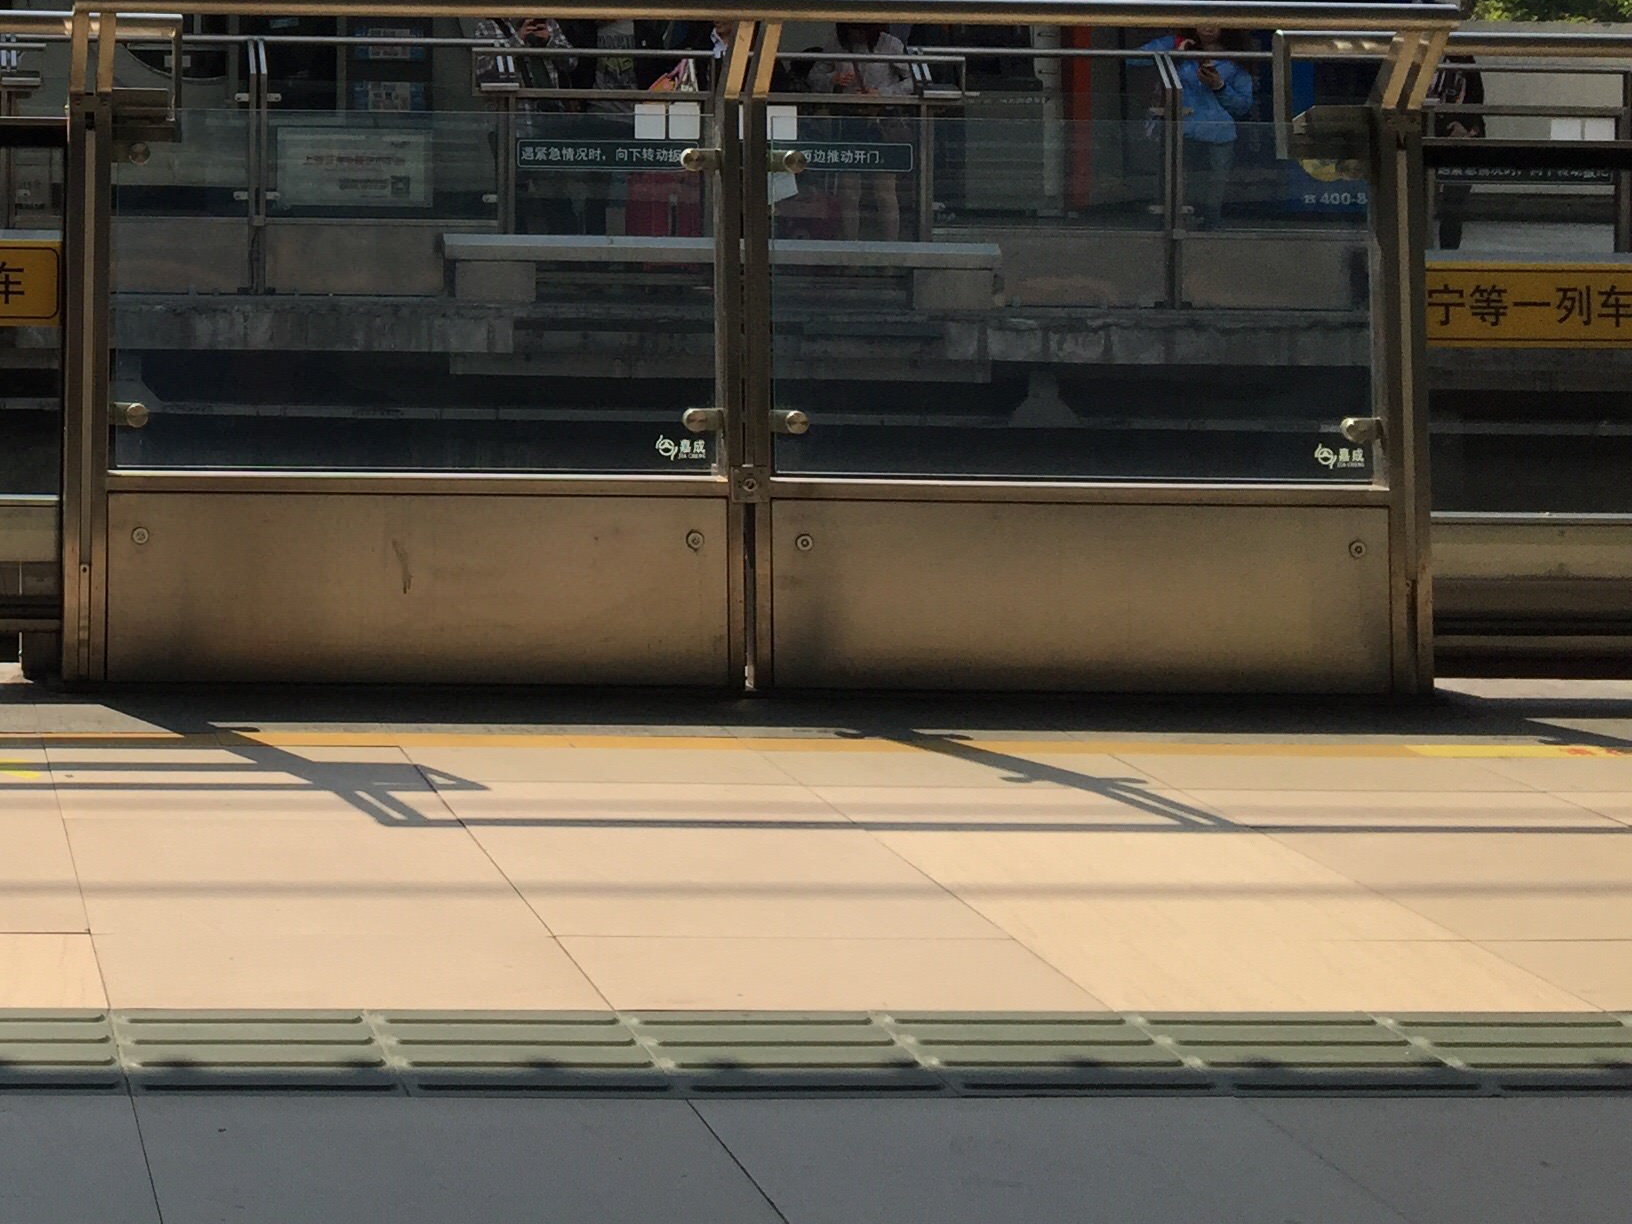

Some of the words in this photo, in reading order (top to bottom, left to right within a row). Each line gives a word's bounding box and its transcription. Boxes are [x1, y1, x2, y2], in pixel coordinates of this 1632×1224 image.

[1427, 283, 1632, 328] 宁等一列车
